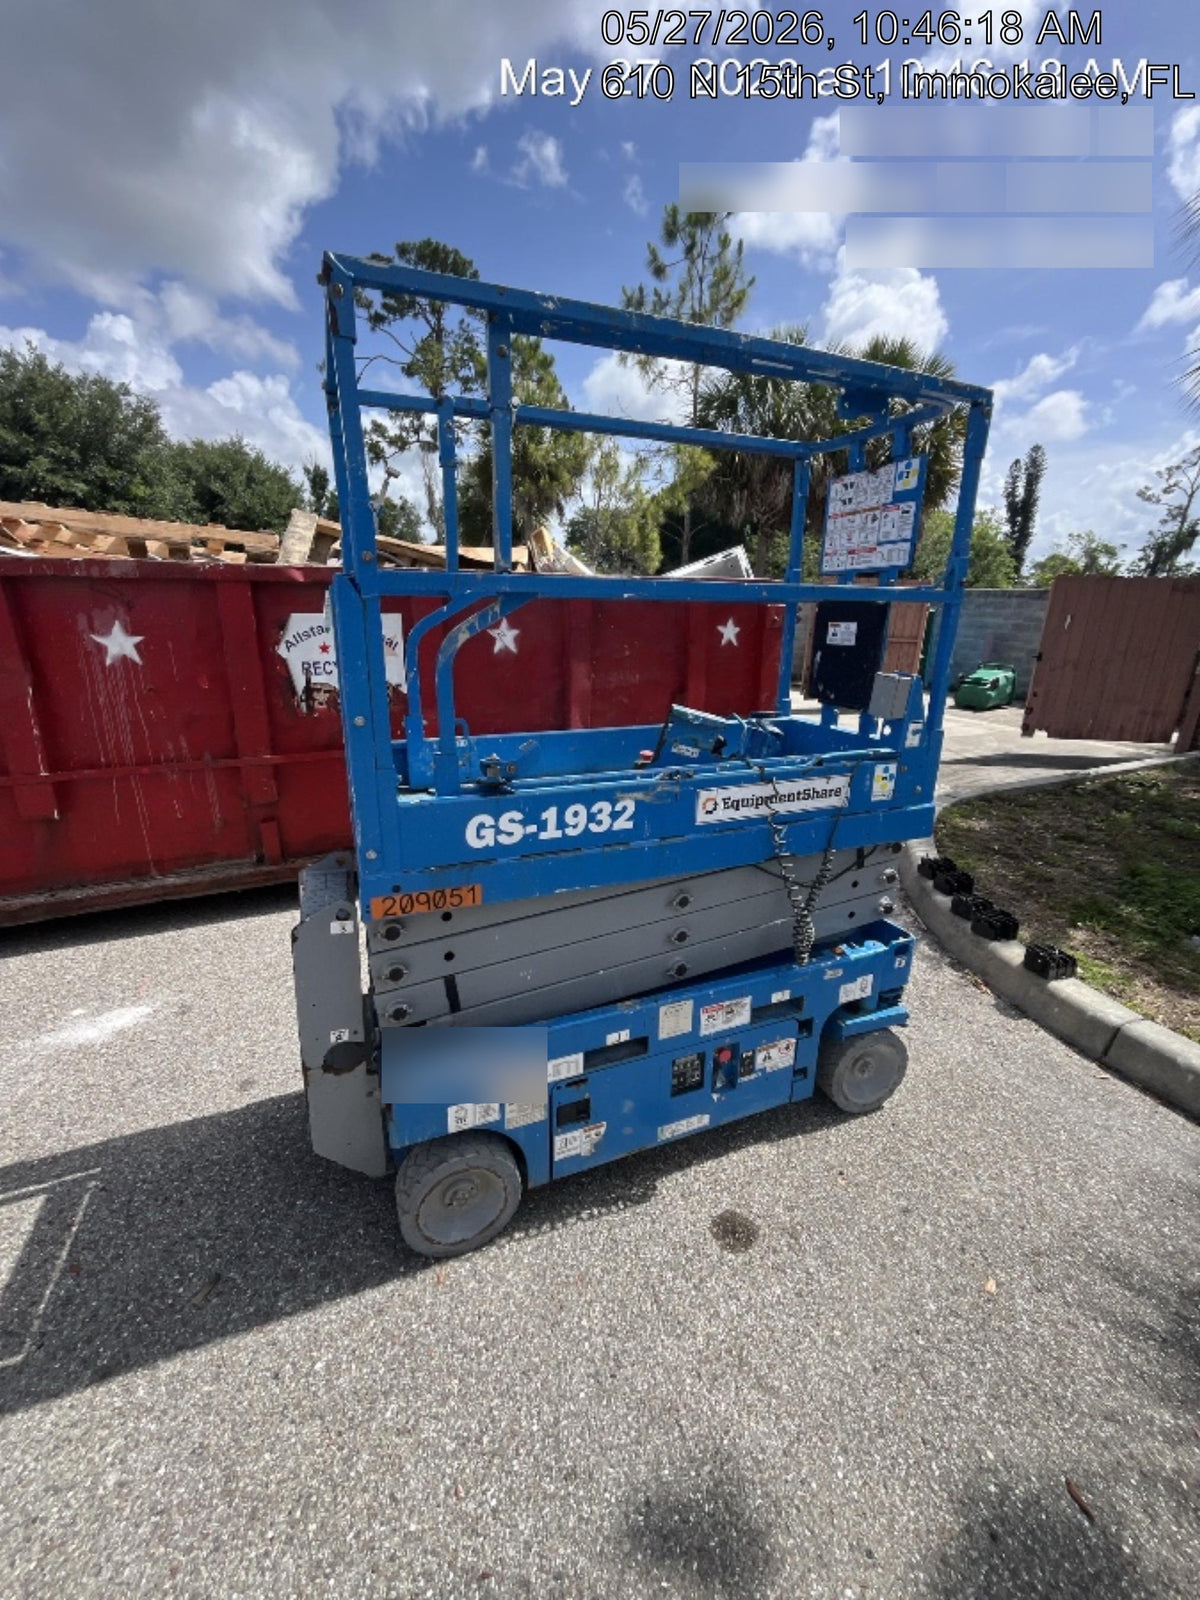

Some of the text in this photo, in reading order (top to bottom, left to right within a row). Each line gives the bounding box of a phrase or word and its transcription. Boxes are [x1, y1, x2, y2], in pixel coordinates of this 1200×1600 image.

[721, 787, 842, 811] EquipmentShare
[465, 800, 636, 849] GS-1932
[381, 885, 477, 917] 209051
